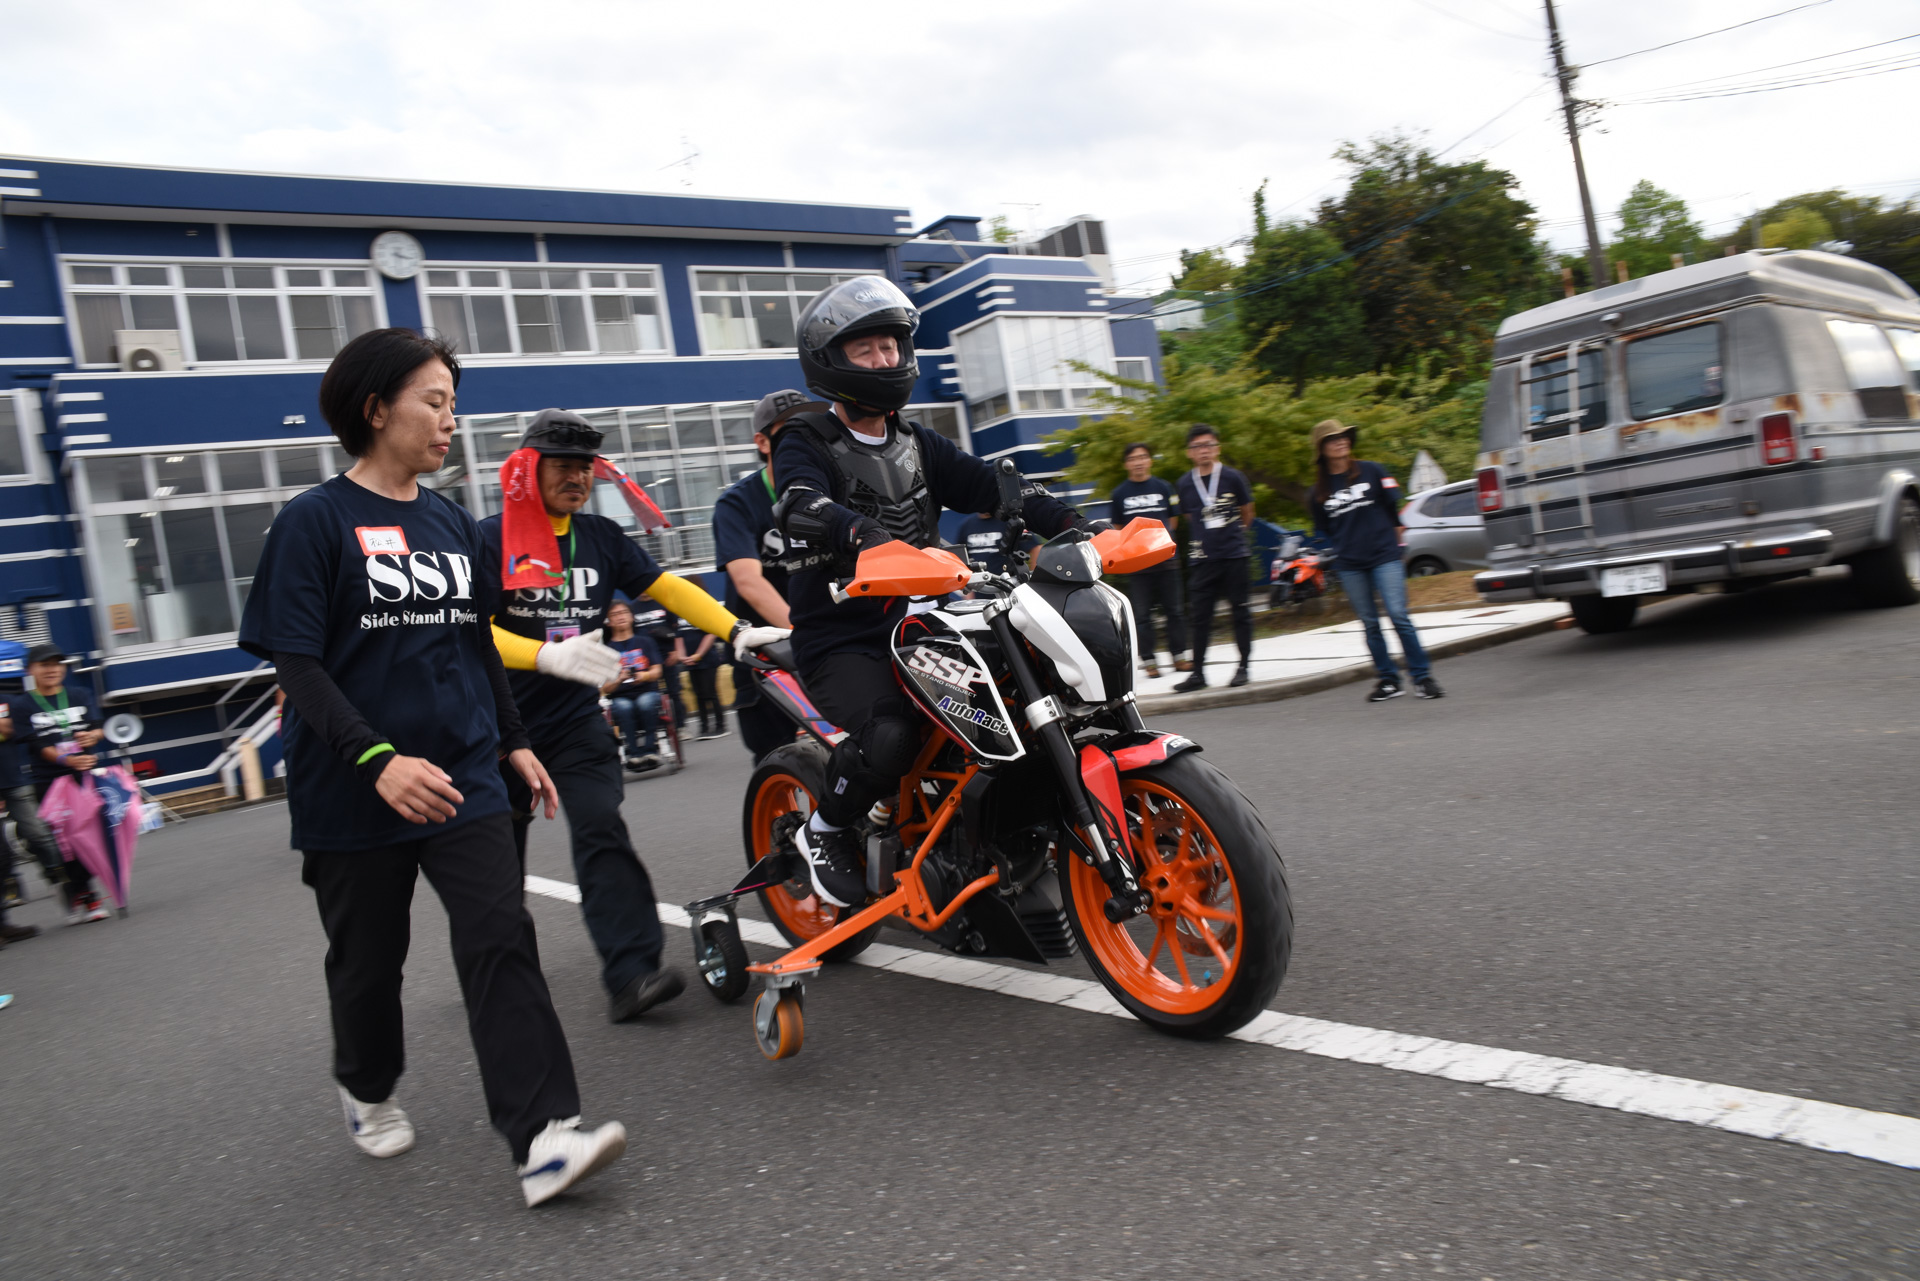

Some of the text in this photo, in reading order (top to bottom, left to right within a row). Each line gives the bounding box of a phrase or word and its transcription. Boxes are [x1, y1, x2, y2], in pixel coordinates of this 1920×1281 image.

[361, 612, 400, 630] Side
[402, 609, 446, 626] Stand
[907, 646, 989, 693] SSP
[920, 671, 944, 686] STAND
[945, 682, 978, 699] PROJECT
[936, 695, 1011, 736] AutoRace
